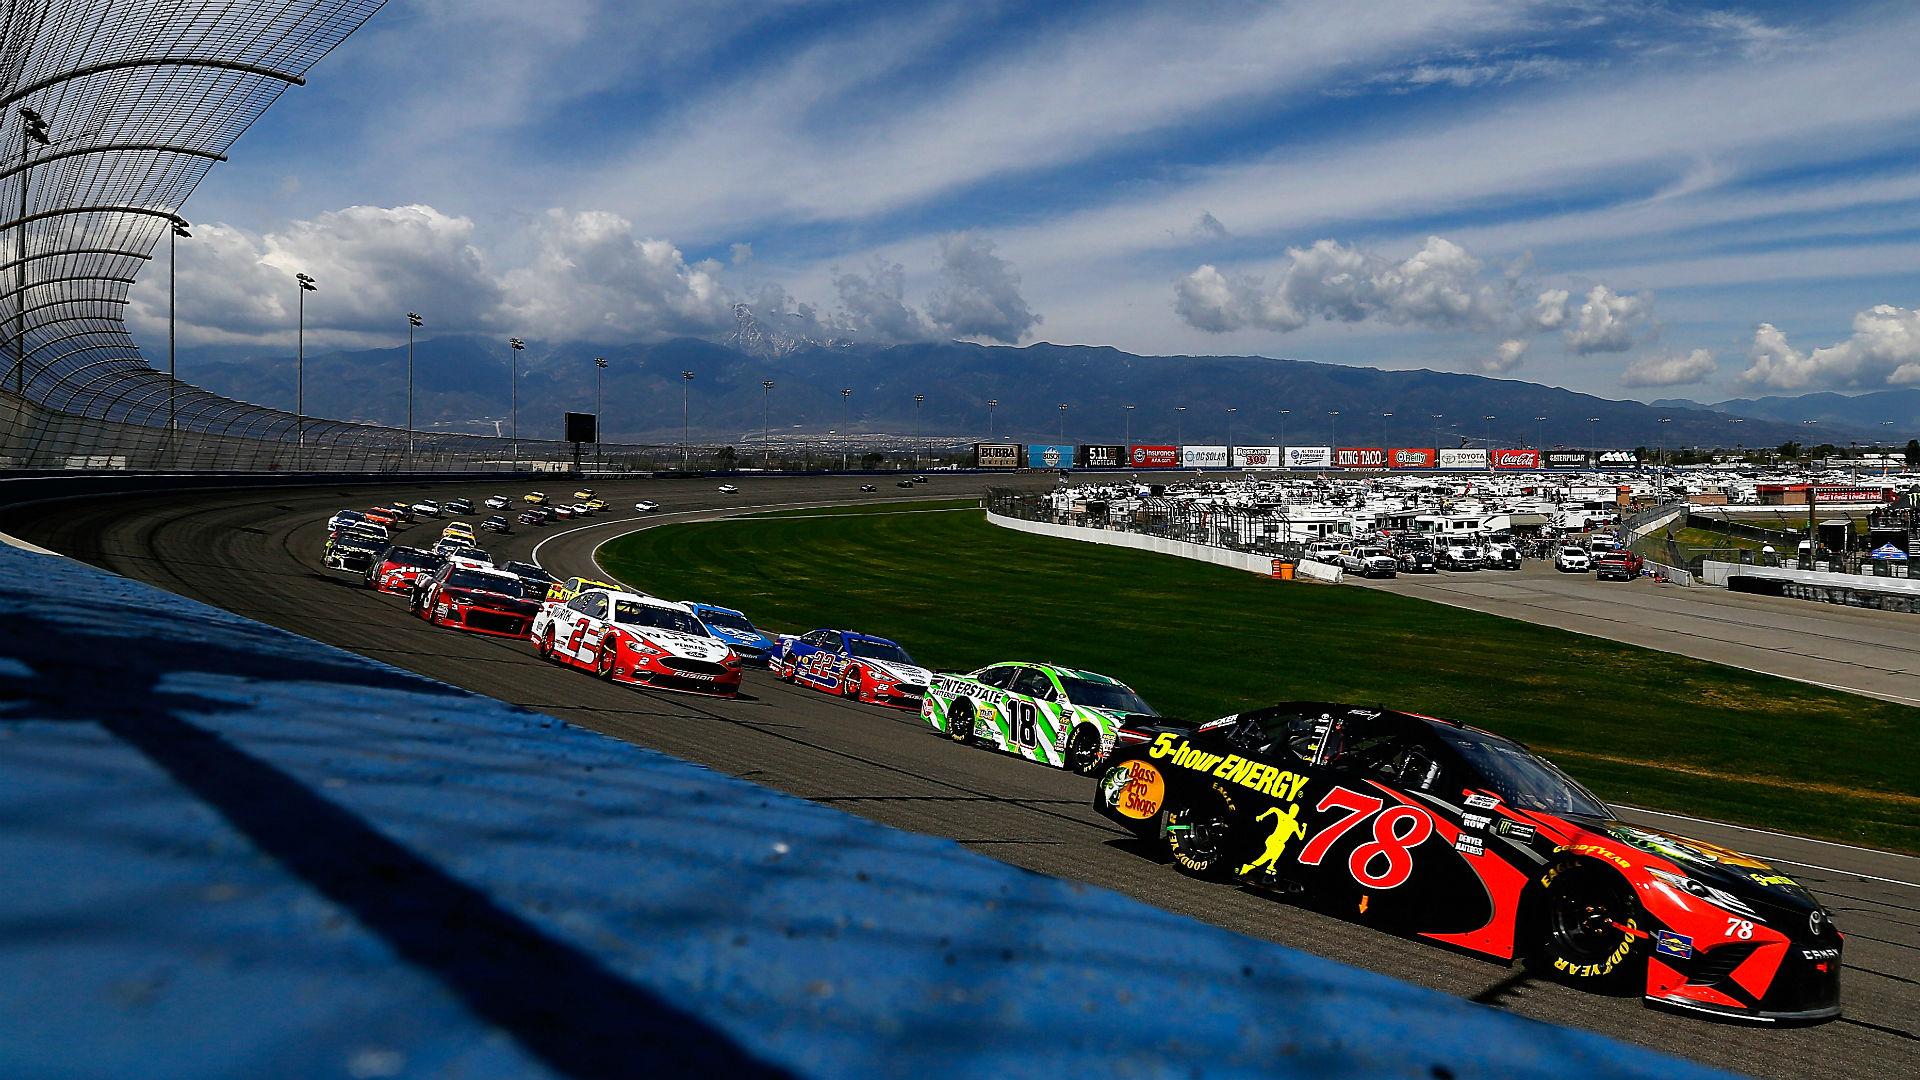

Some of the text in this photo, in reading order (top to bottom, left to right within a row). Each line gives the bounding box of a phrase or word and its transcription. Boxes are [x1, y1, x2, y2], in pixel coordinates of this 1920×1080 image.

[1089, 448, 1108, 459] 5.11
[1205, 452, 1226, 461] SOLAR
[1246, 455, 1267, 466] 300
[1338, 450, 1382, 465] KING TACO
[567, 617, 591, 655] 2
[810, 651, 836, 680] 22
[940, 679, 1004, 705] INTERSTATE
[1006, 699, 1038, 748] 18
[1130, 761, 1156, 784] Bass
[1148, 732, 1225, 773] 5-hour
[1212, 753, 1310, 803] ENERGY
[1129, 779, 1148, 796] Pro
[1125, 792, 1157, 817] Shops
[1463, 819, 1486, 830] ROW
[1297, 785, 1434, 890] 78
[1724, 917, 1754, 940] 78
